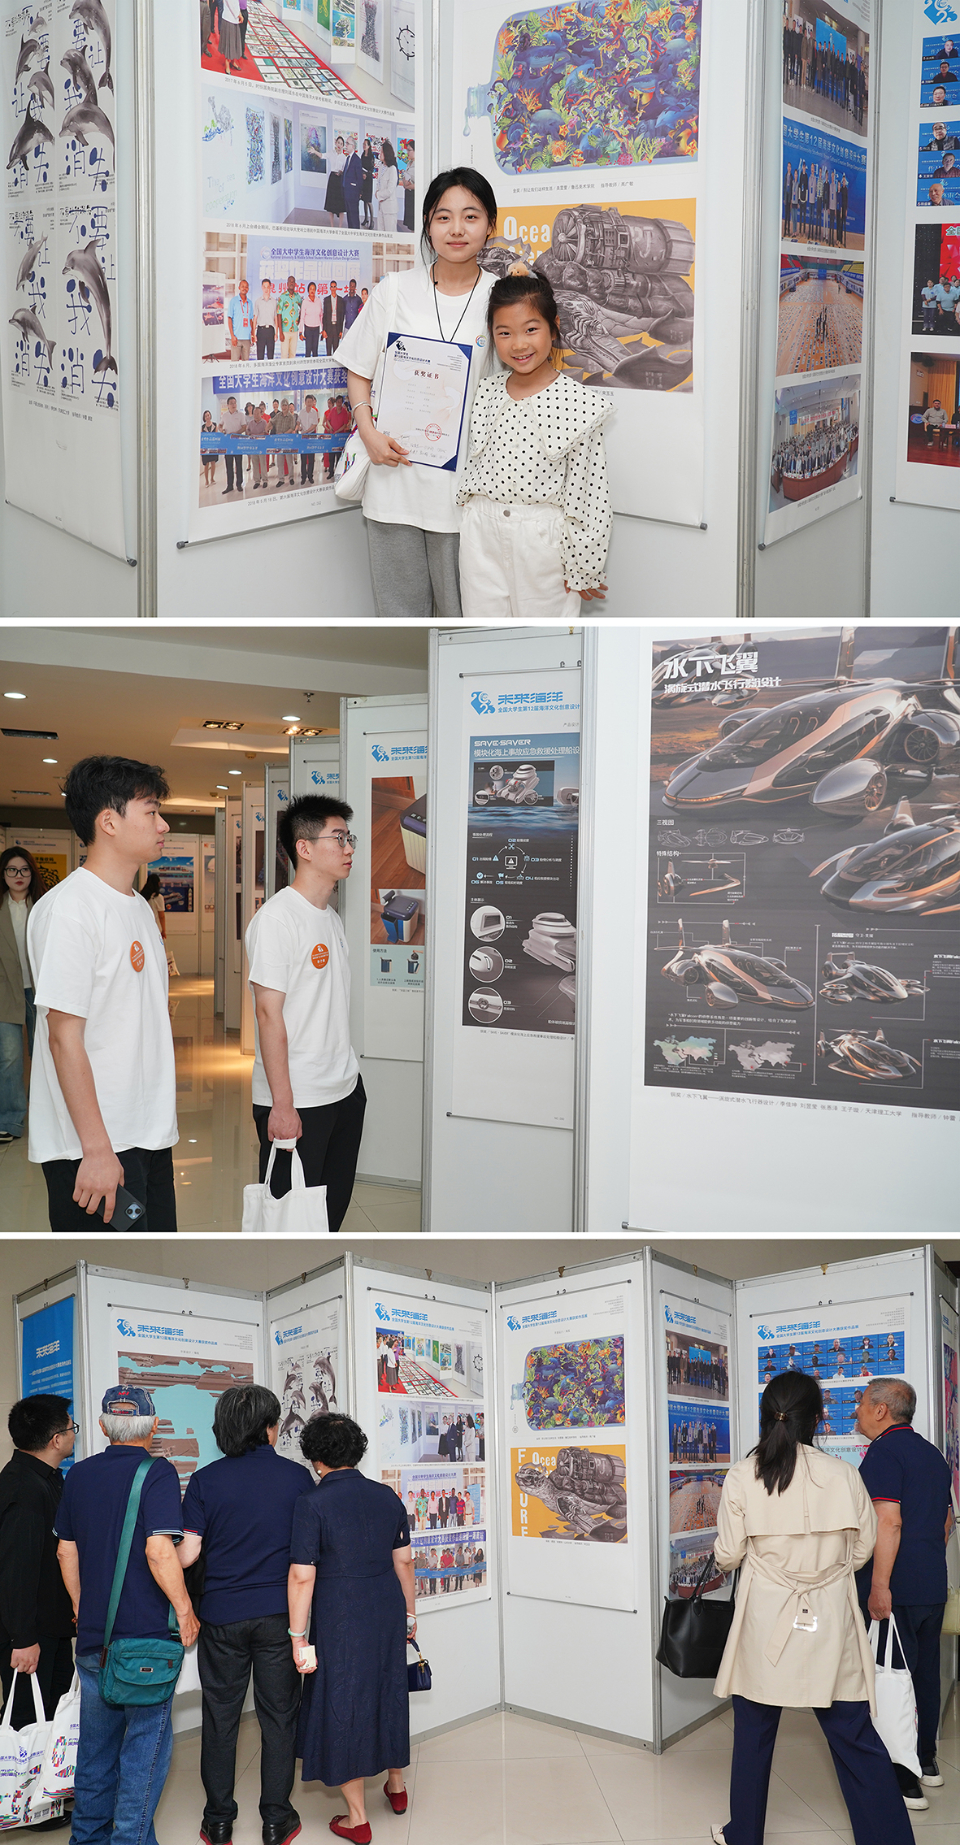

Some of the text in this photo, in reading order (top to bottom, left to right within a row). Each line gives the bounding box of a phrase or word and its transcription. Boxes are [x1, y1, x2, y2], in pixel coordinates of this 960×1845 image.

[88, 41, 104, 68] 让
[271, 247, 360, 258] 全国大中学生海洋文化创意设计大赛
[66, 279, 93, 336] 我
[414, 369, 440, 380] 获奖证书
[663, 652, 758, 679] 水下飞翼
[498, 691, 564, 705] 未来海洋
[498, 703, 580, 713] 全国大学生第12届海洋文化创意设计
[656, 850, 680, 858] 特殊结构
[391, 1308, 428, 1321] 未来海洋
[522, 1310, 557, 1324] 未来海洋
[137, 1324, 184, 1336] 未来海洋
[776, 1320, 821, 1333] 未来海洋
